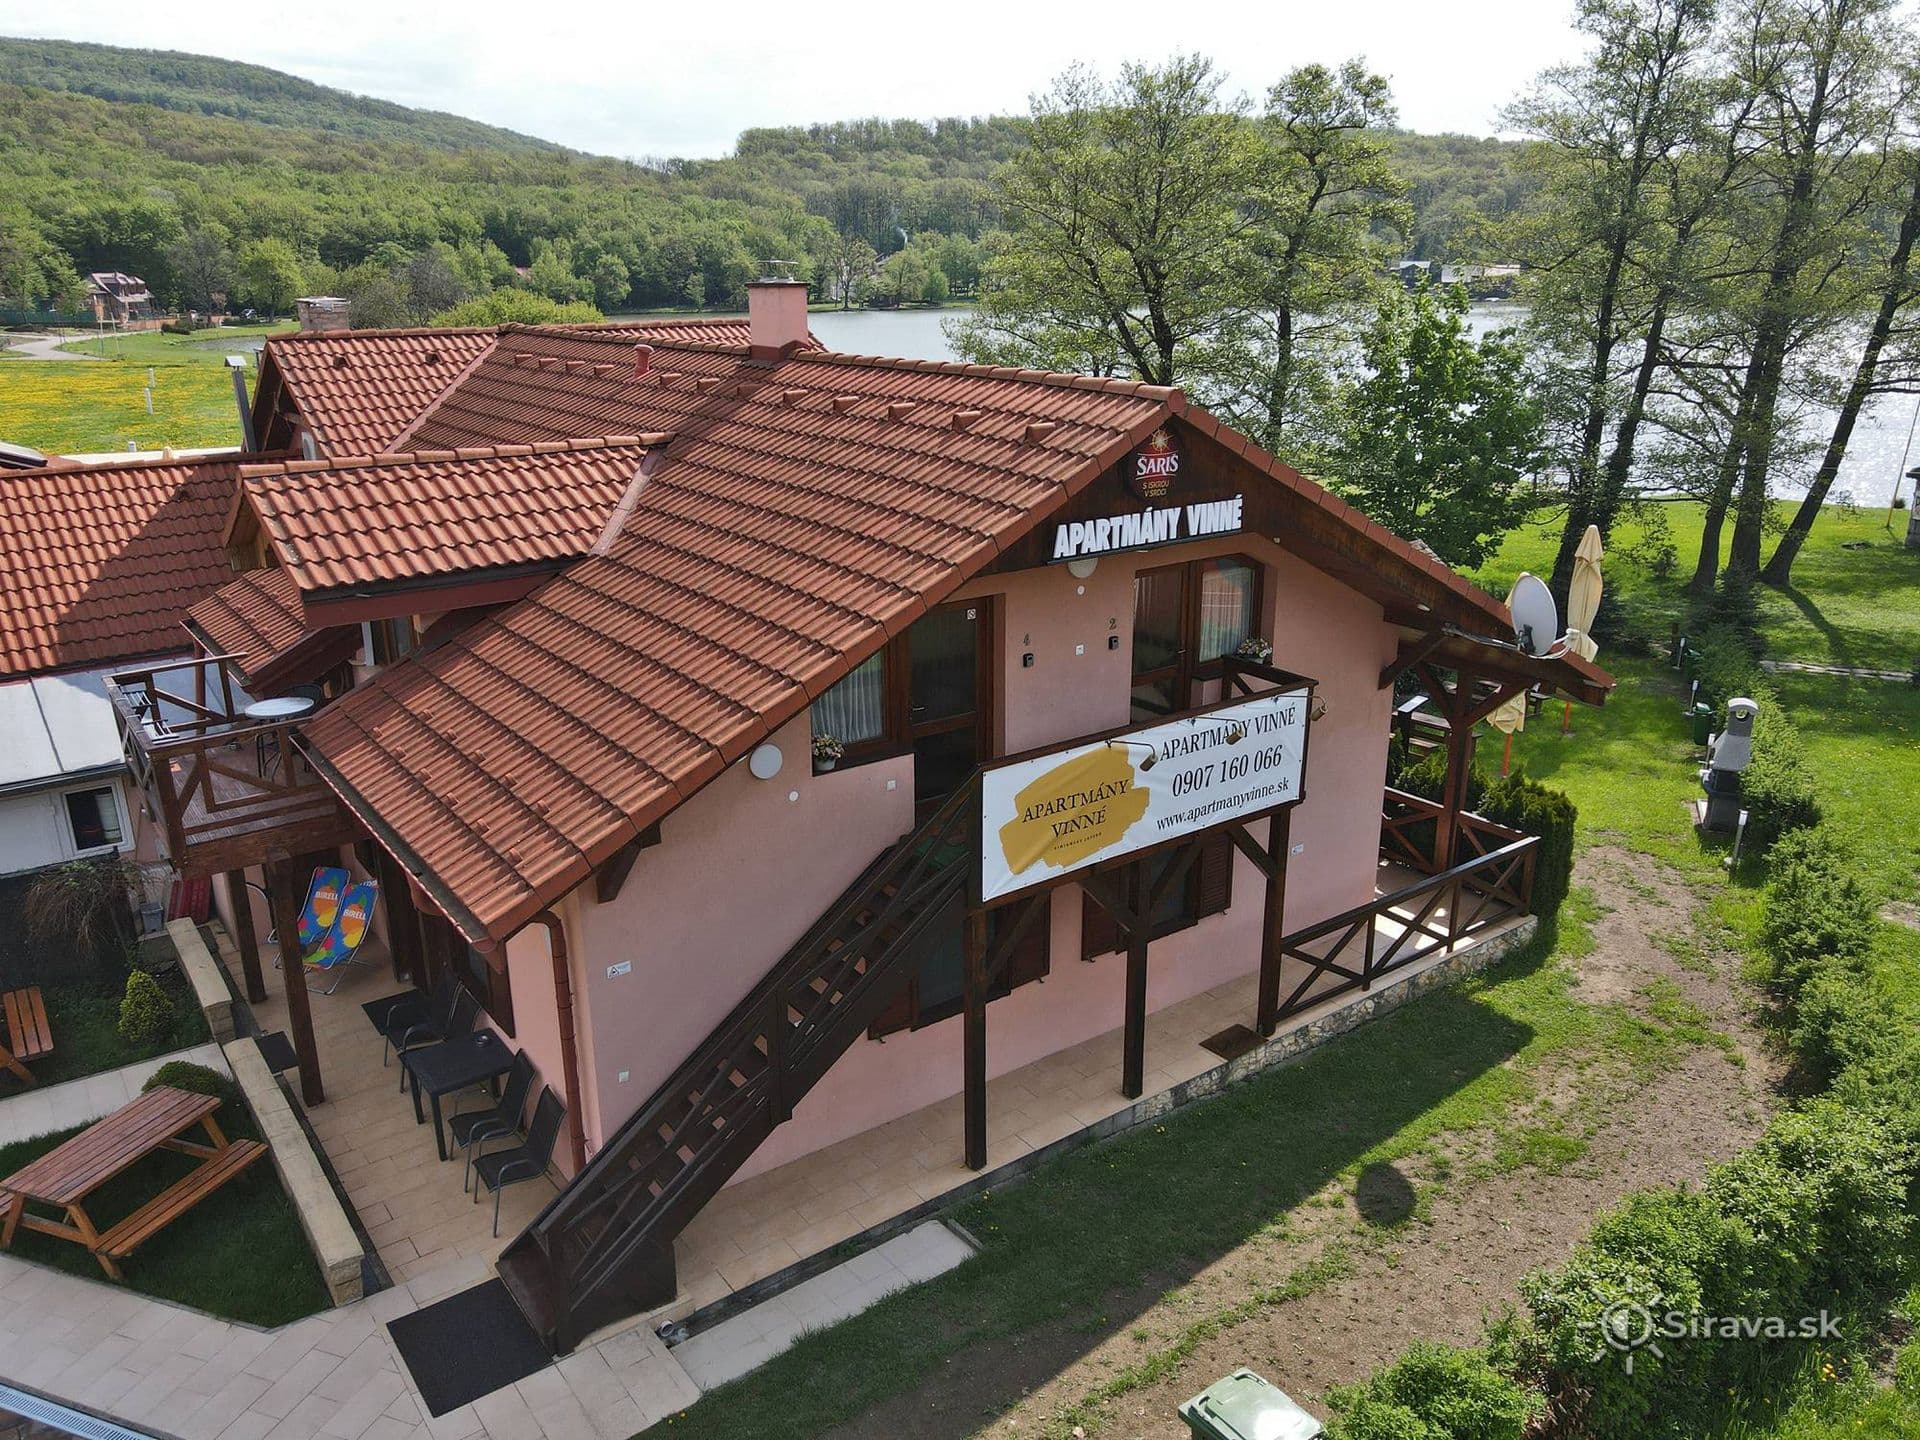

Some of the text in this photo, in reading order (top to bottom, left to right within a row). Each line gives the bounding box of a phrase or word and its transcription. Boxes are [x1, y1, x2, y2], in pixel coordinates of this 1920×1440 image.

[1136, 453, 1179, 476] ŠARIŠ
[1053, 494, 1243, 559] APARTMÁNY VINNÉ
[1109, 617, 1117, 630] 2
[1255, 702, 1296, 735] VINNÉ
[1172, 744, 1283, 797] 0907 160 066
[1022, 779, 1129, 823] APARTMÁNY
[1156, 777, 1289, 831] www.apartmanyvinne.sk
[1051, 805, 1107, 838] VINNÉ
